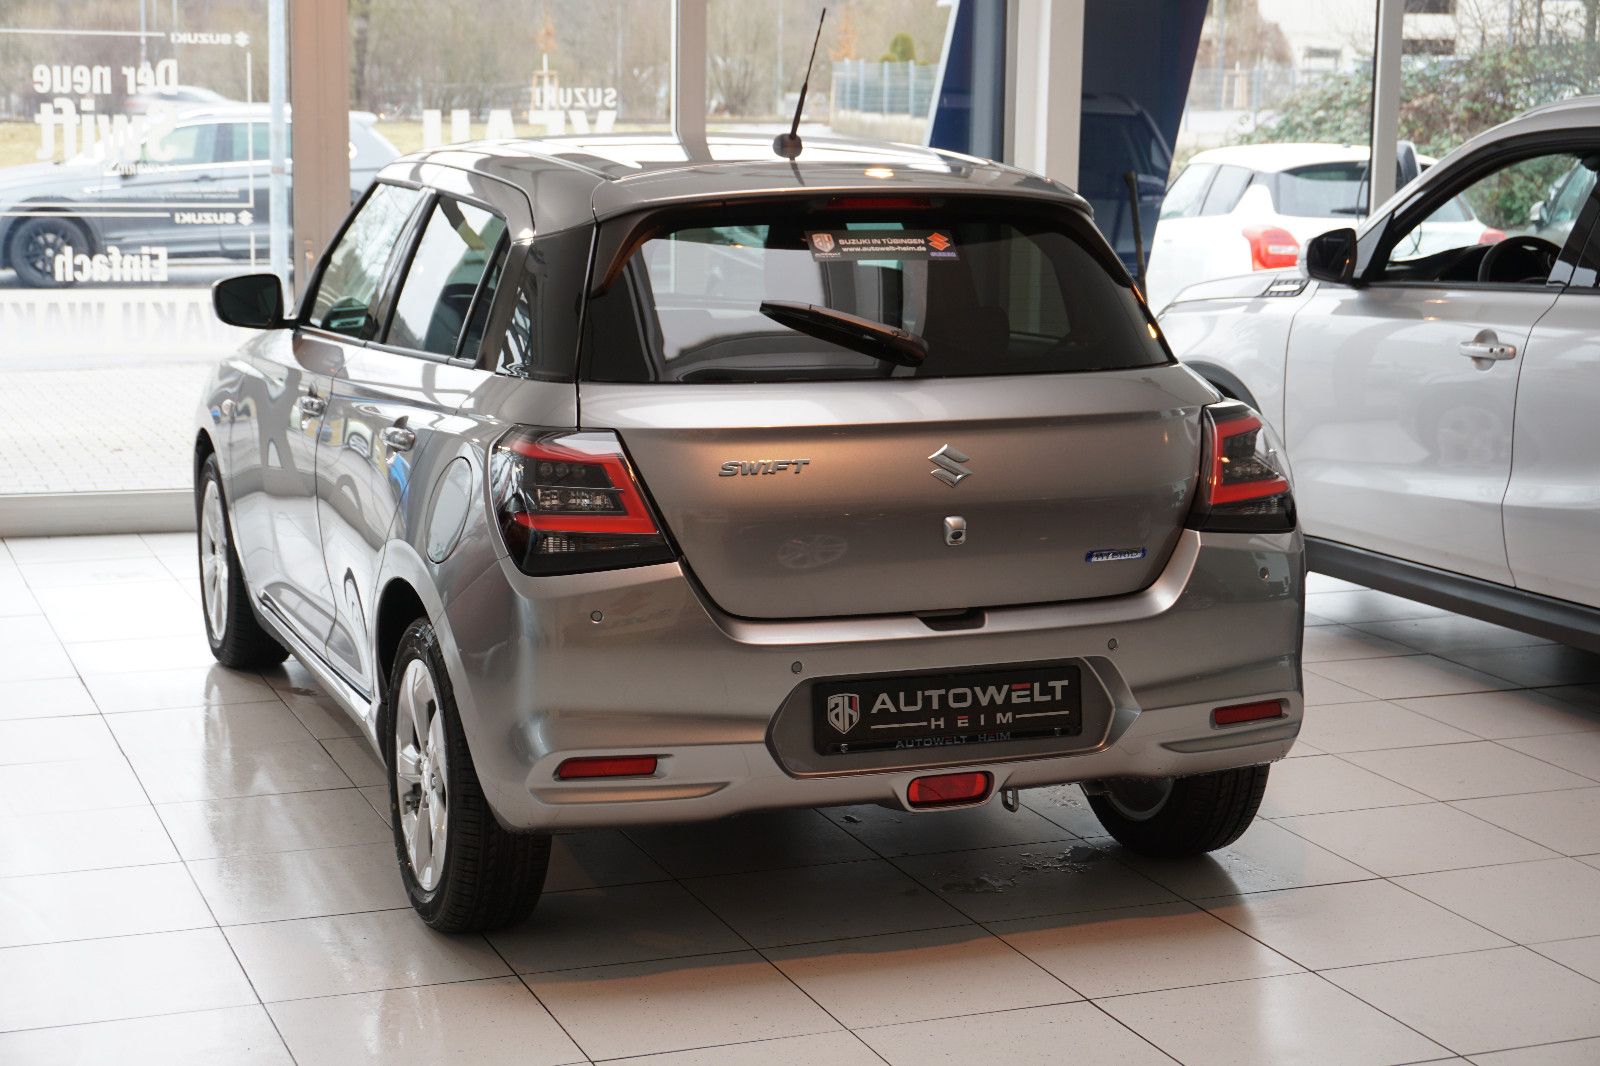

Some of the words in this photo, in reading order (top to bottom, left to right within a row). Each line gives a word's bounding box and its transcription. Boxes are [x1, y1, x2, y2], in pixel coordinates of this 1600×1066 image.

[838, 238, 870, 246] SUZUKI
[871, 238, 881, 246] IN
[718, 458, 810, 477] SWIFT
[870, 679, 1069, 714] AUTOWELT
[930, 712, 1013, 730] HEIM
[895, 734, 967, 749] AUTOWELT
[977, 731, 1011, 743] HEIM
